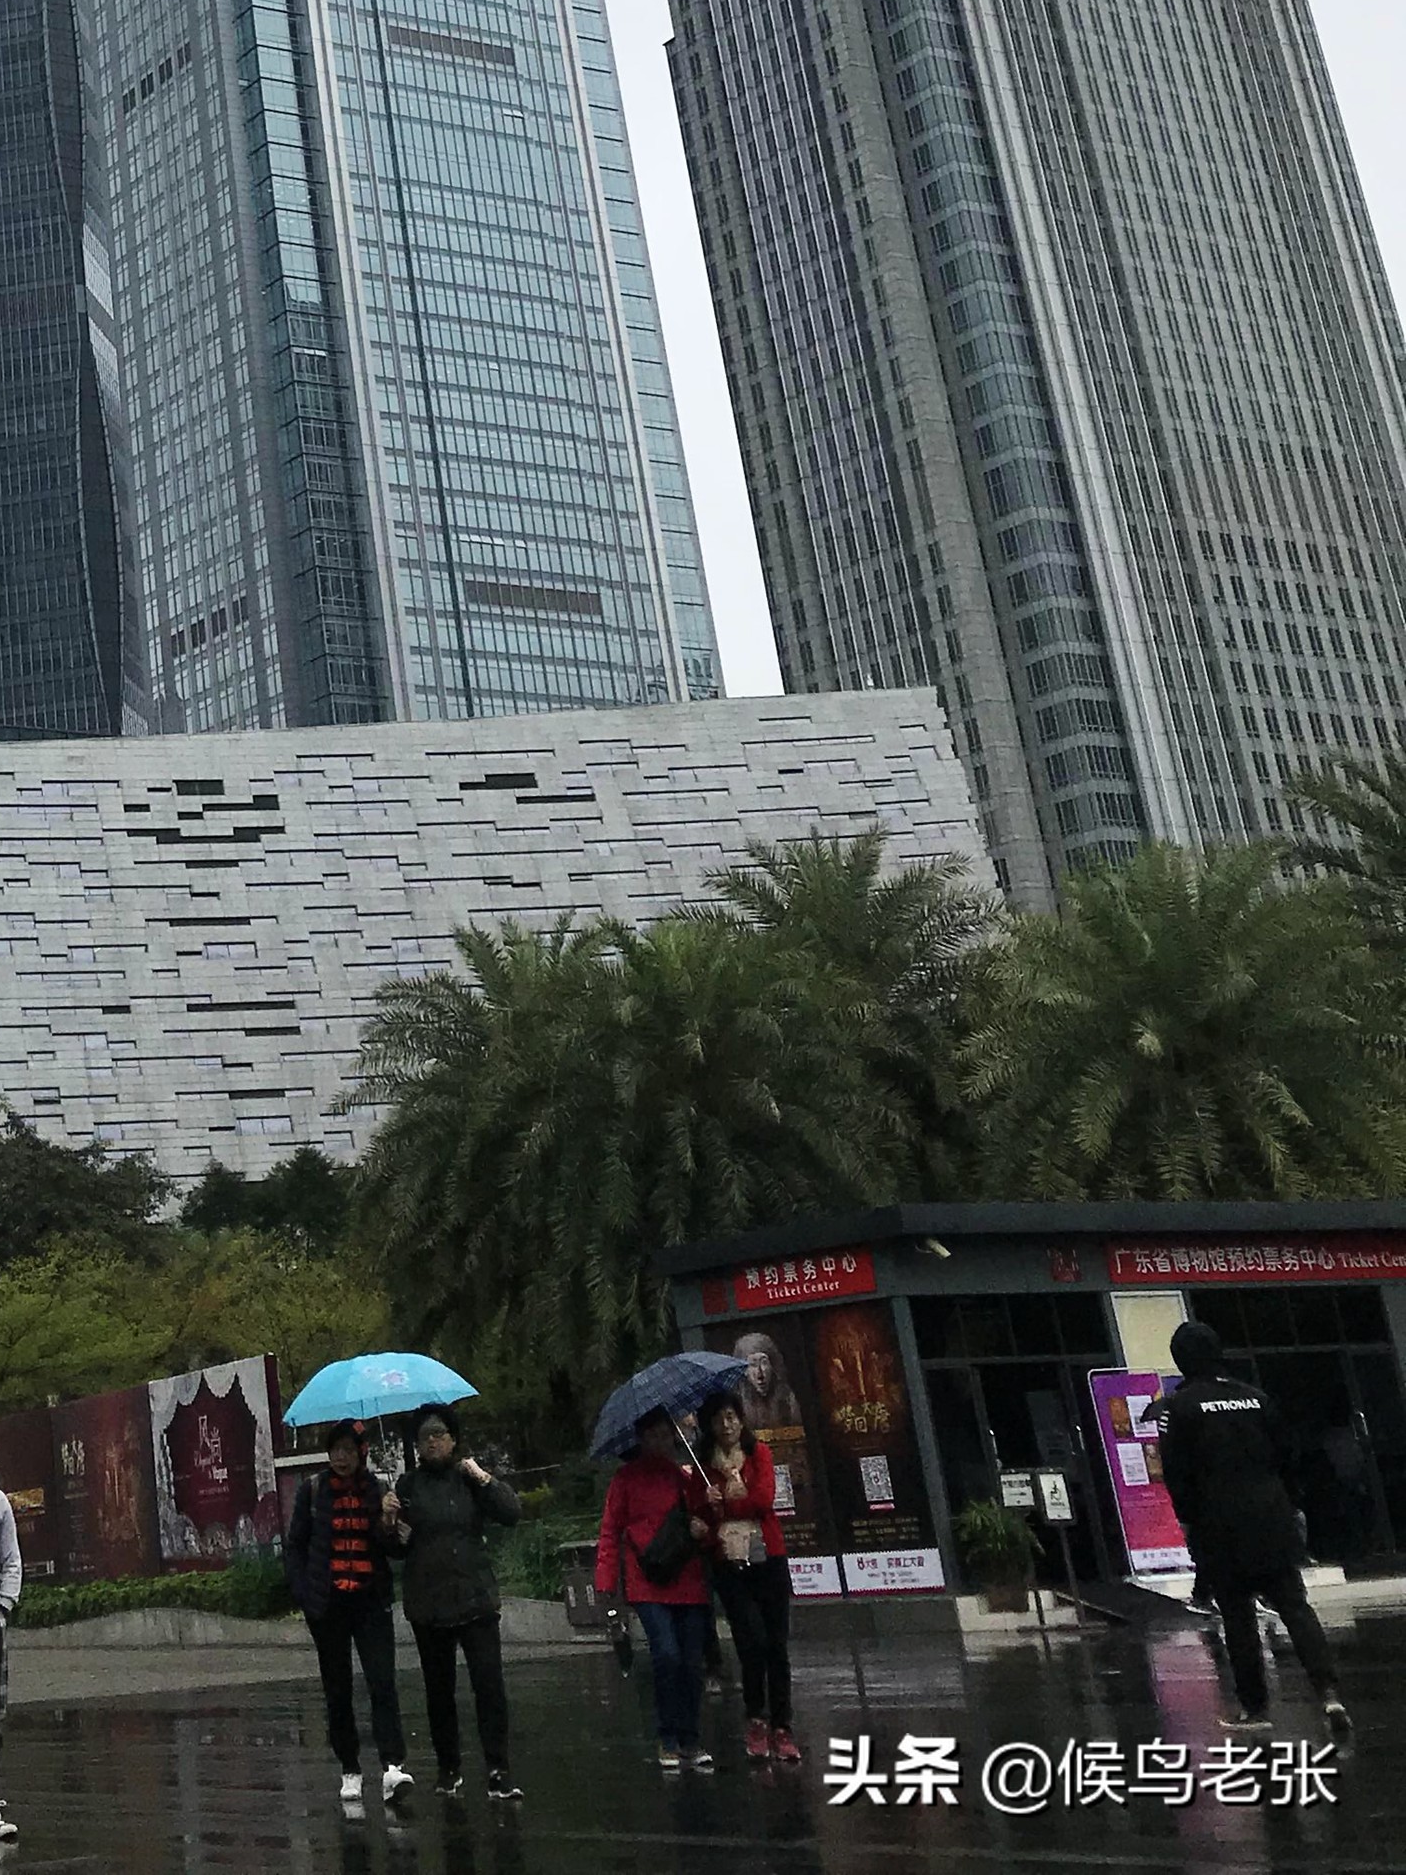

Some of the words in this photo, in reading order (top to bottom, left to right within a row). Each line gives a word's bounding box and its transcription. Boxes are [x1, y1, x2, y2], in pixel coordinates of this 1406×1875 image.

[745, 1253, 857, 1289] 预约票务中心
[1114, 1246, 1336, 1274] 广东省博物馆预约票务中心
[1337, 1251, 1380, 1268] Ticket
[766, 1285, 801, 1300] Ticket
[803, 1280, 840, 1294] Center
[1199, 1397, 1261, 1413] PETRONAS
